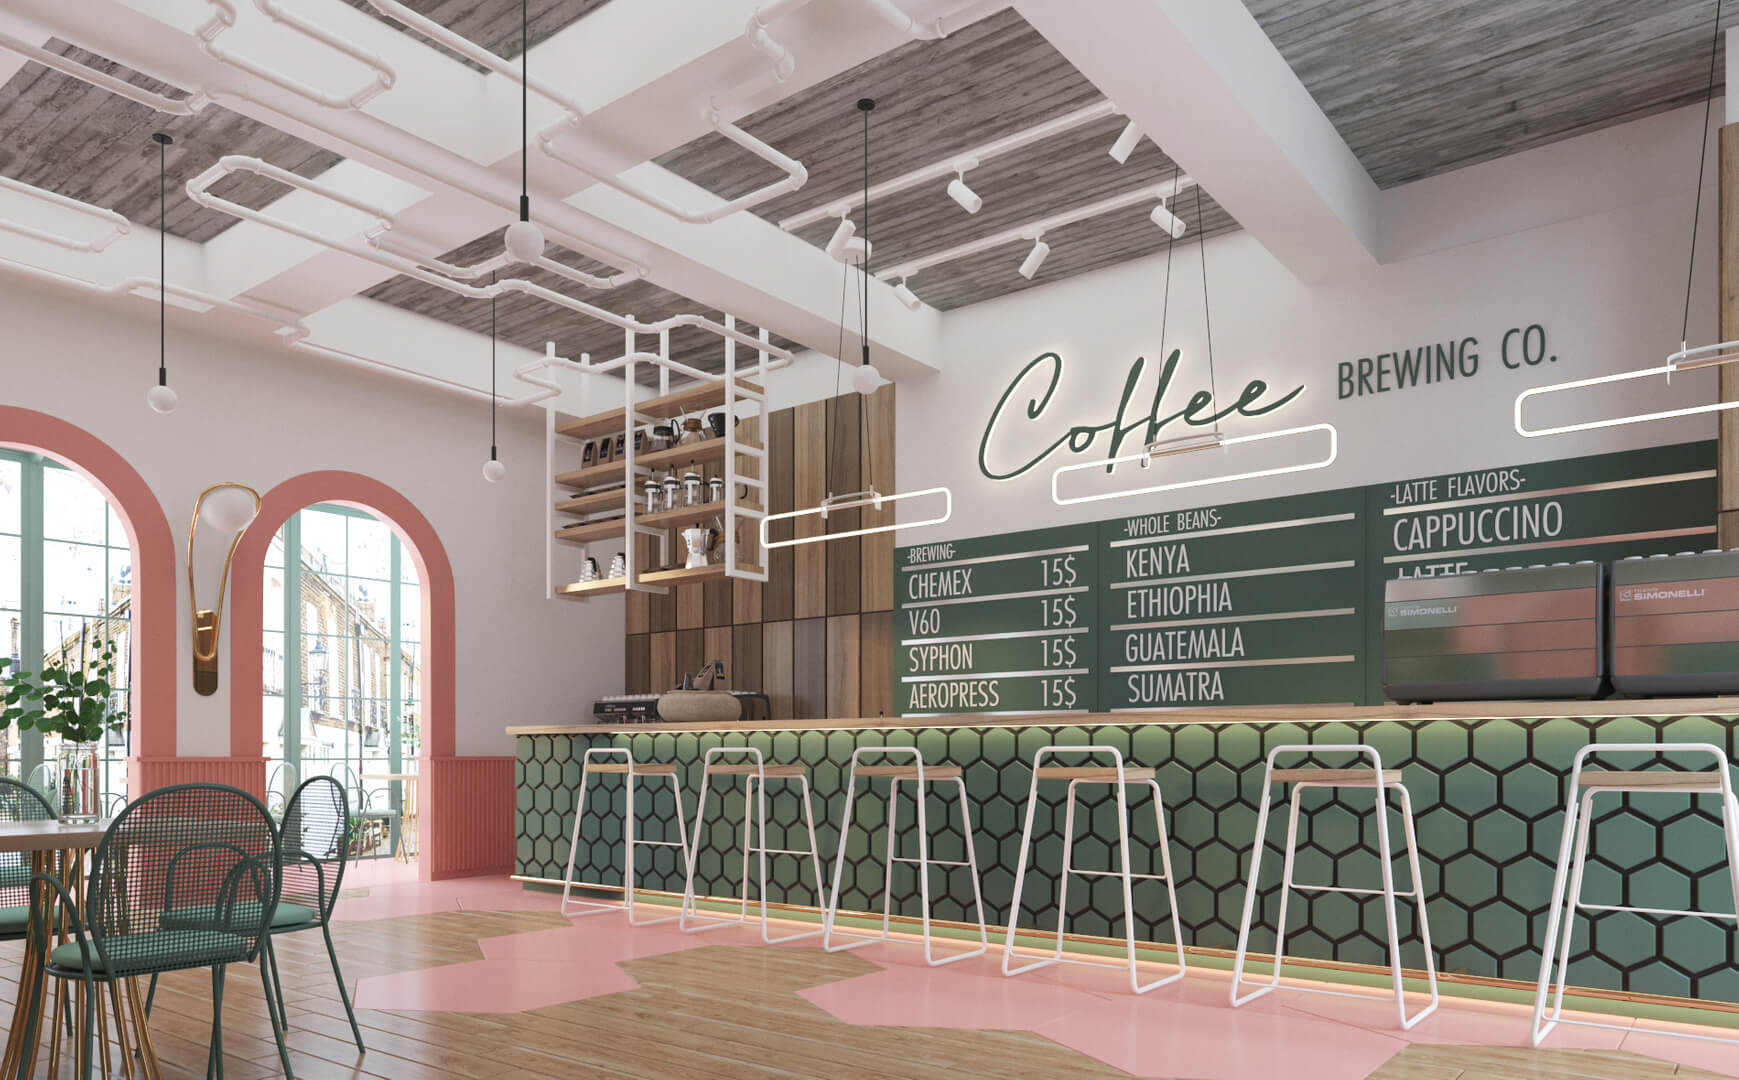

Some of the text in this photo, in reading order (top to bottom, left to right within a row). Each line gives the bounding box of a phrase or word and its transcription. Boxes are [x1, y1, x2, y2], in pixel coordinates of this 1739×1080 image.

[979, 323, 1558, 480] Coffee BREWING CO.
[1393, 501, 1563, 551] CAPPUCCINO
[908, 554, 1077, 600] CHEMEX 15$
[1126, 544, 1190, 578] KENYA
[908, 595, 1077, 635] V60 15$
[1127, 582, 1232, 619] ETHIOPHIA
[909, 635, 1077, 673] SYPHON 15$
[1125, 626, 1245, 663] GUATEMALA
[909, 676, 1077, 709] AEROPRESS 15$
[1127, 671, 1224, 703] SUMATRA
